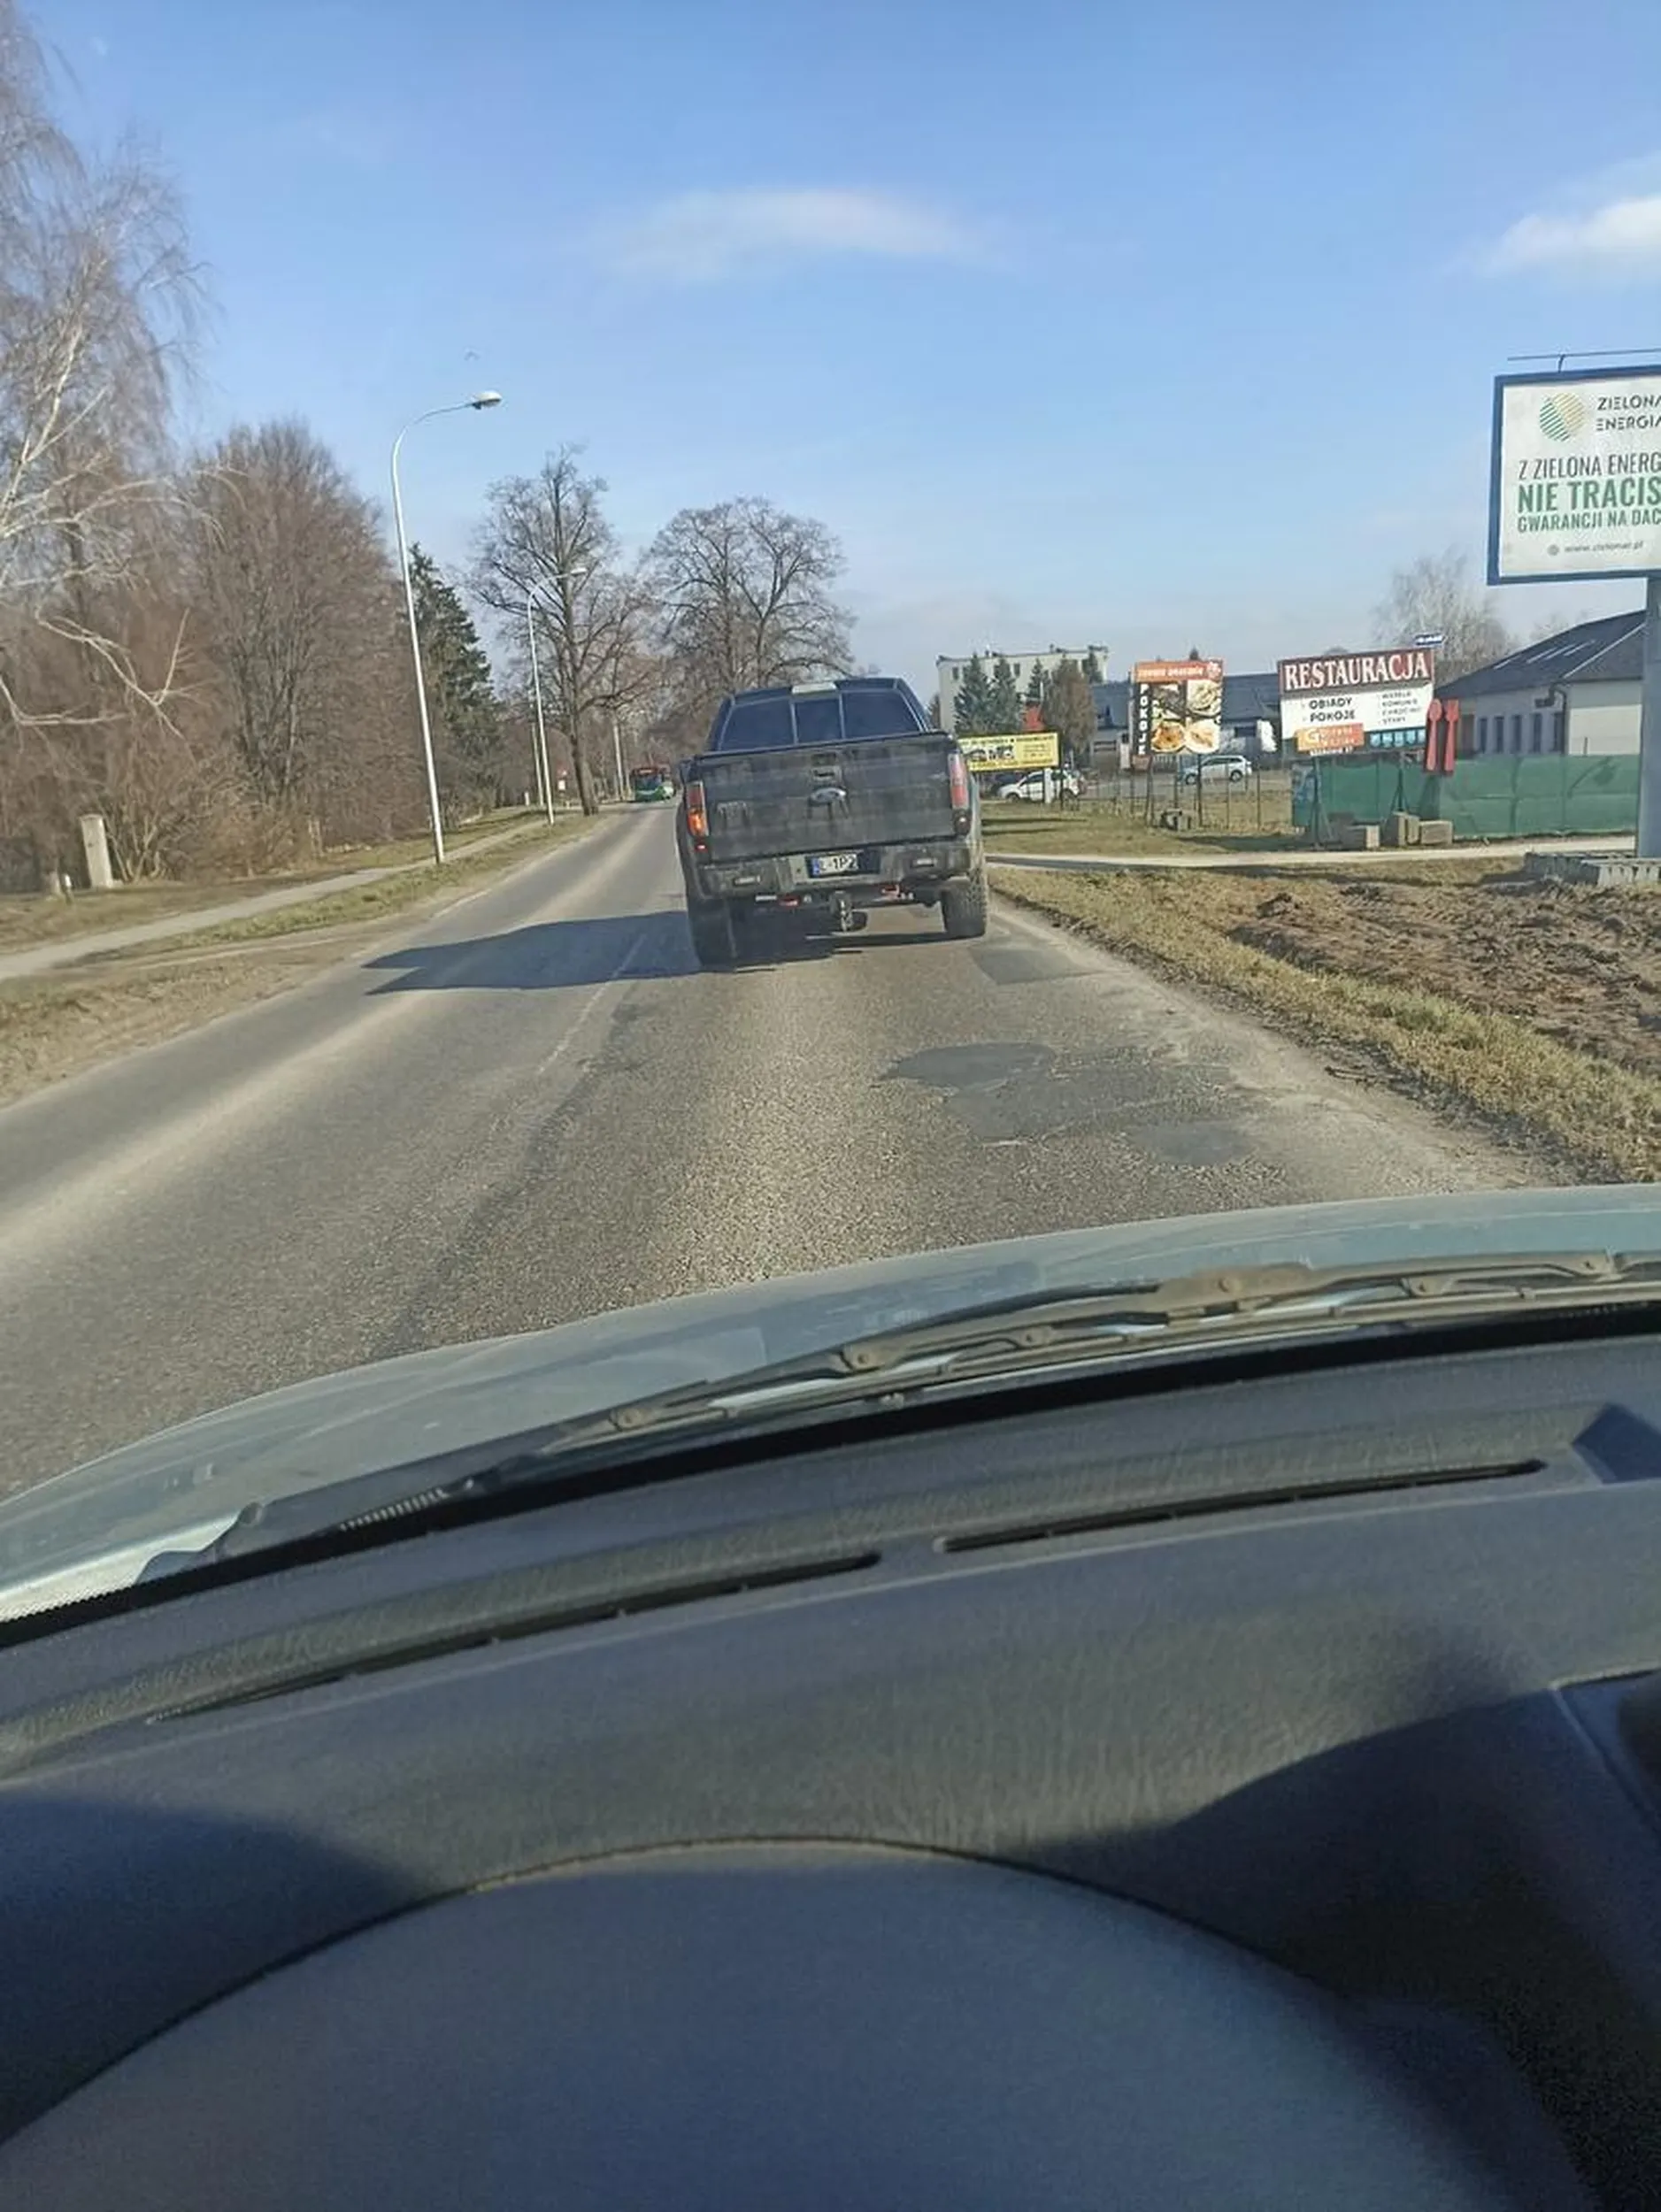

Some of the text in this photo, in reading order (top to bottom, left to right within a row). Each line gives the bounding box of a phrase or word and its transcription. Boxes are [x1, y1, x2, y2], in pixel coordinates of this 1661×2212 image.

[1519, 459, 1528, 480] Z
[1534, 456, 1603, 480] ZIELONA
[1518, 483, 1558, 513] NIE
[1518, 511, 1603, 533] GWARANCJI
[1607, 510, 1627, 526] NA
[1284, 652, 1429, 691] RESTAURACJA
[1310, 697, 1352, 710] OBIADY
[1136, 683, 1150, 756] POKOJE
[1310, 710, 1355, 722] POKOJE
